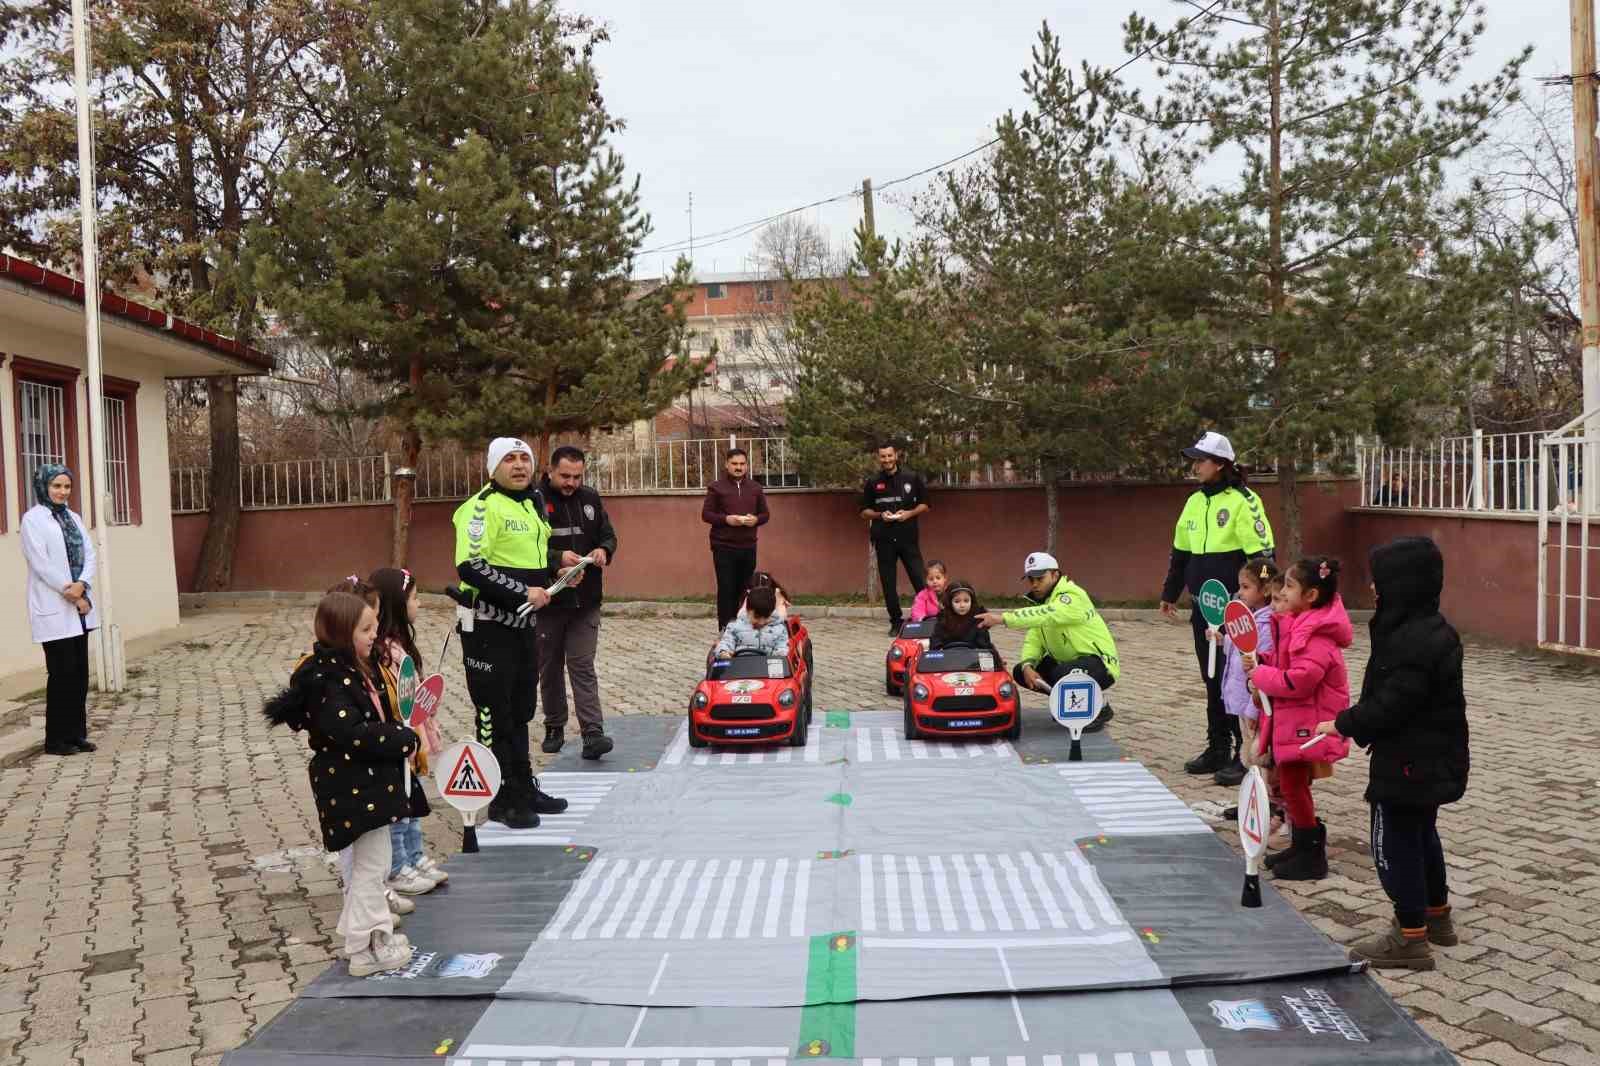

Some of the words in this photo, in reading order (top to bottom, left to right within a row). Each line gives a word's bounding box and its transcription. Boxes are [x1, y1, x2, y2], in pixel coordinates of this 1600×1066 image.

[1202, 591, 1225, 616] GEÇ
[1228, 615, 1253, 638] DUR
[415, 686, 437, 712] DUR
